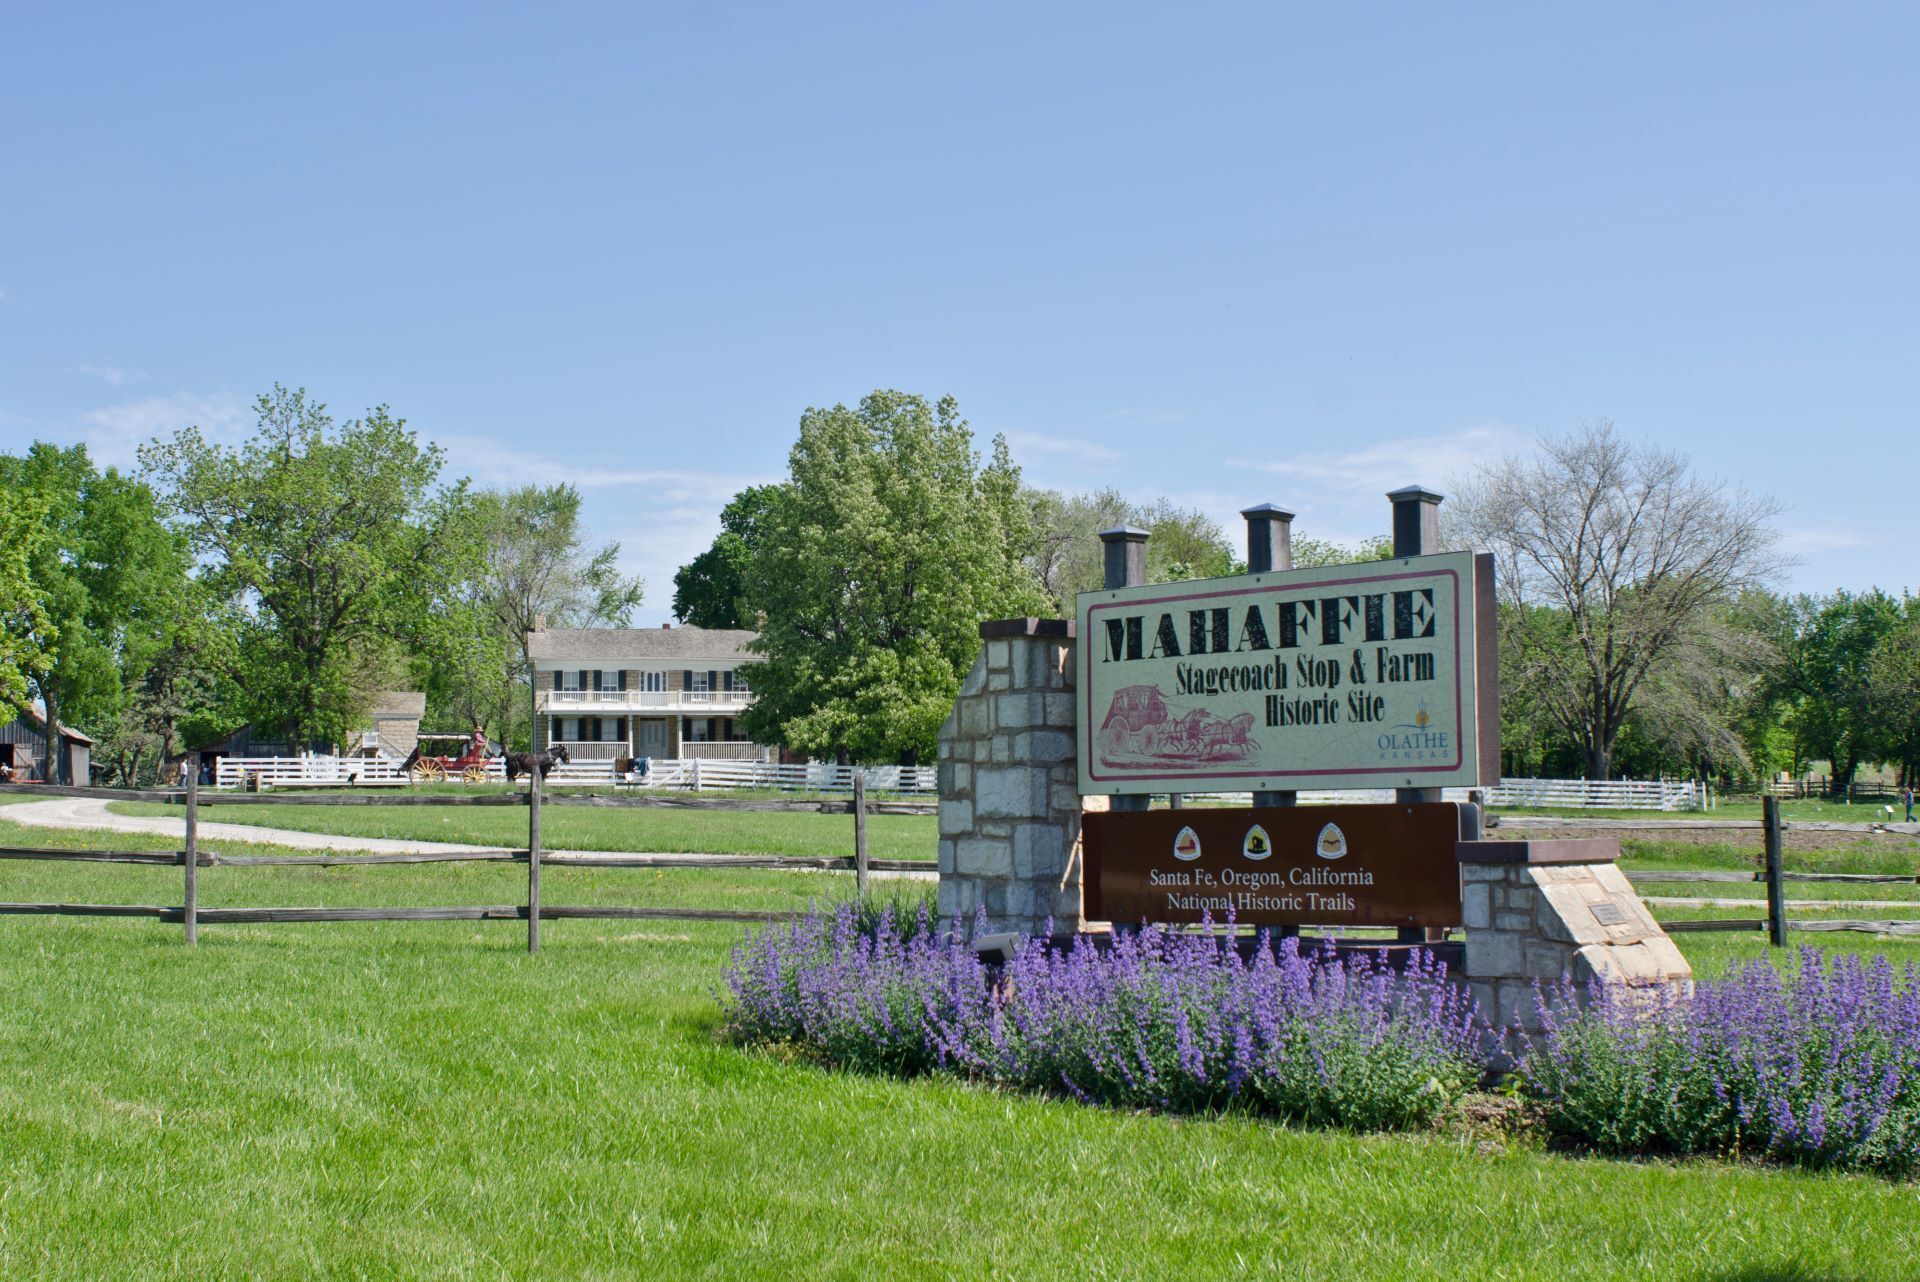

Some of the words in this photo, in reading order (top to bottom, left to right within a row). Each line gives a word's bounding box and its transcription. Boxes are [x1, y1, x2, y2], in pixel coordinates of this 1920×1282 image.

[1102, 588, 1436, 663] MAHAFFIE
[1176, 655, 1288, 696] Stagecoach
[1296, 653, 1341, 689] Stop
[1350, 648, 1367, 685] &
[1376, 646, 1435, 684] Farm
[1265, 693, 1340, 727] Historic
[1348, 689, 1385, 723] Site
[1377, 732, 1449, 750] OLATHE
[1379, 749, 1449, 759] KANSAS
[1150, 868, 1190, 886] Santa
[1194, 868, 1217, 889] Fe,
[1221, 867, 1285, 890] Oregon,
[1289, 866, 1374, 886] California
[1167, 892, 1233, 910] National
[1237, 892, 1303, 911] Historic
[1306, 892, 1355, 911] Trails
